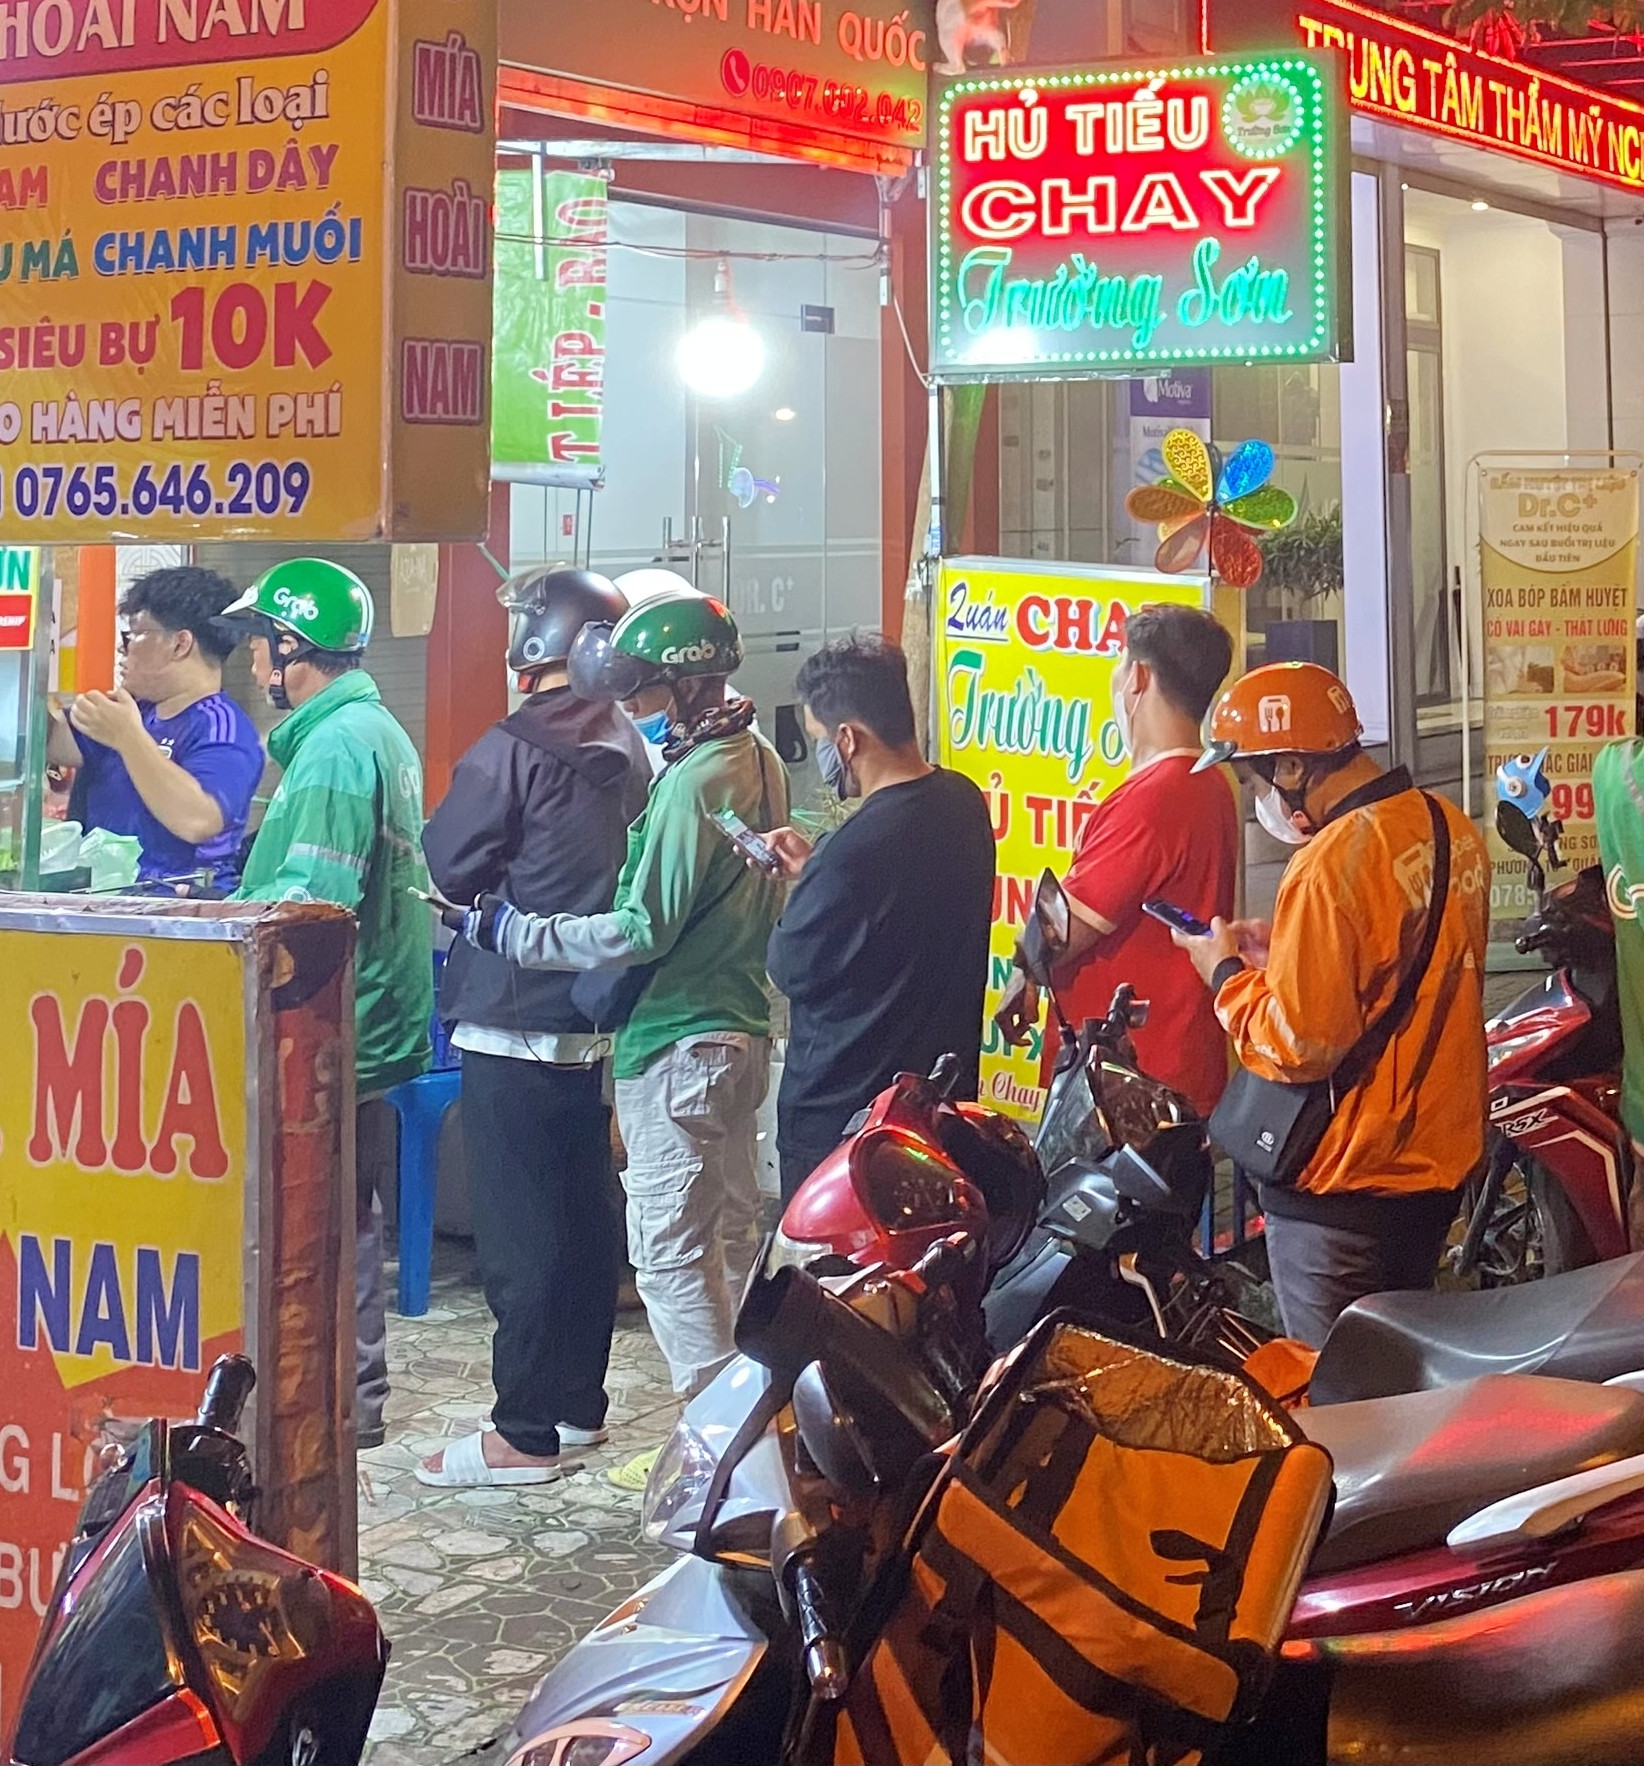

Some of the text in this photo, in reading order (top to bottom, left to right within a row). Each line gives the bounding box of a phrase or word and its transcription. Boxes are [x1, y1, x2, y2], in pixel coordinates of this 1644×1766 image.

[838, 10, 926, 70] QUỐC
[0, 68, 330, 146] ước ép các loại
[414, 34, 482, 132] MÍA
[1422, 51, 1485, 132] TÂM
[1488, 77, 1562, 157] THẨM
[1567, 106, 1601, 168] MỸ
[964, 78, 1209, 162] HỦ TIẾU
[93, 151, 238, 204] CHANH
[247, 138, 339, 192] DÂY
[961, 167, 1281, 239] CHAY
[20, 228, 79, 284] MÁ
[93, 226, 238, 277] CHANH
[247, 201, 363, 268] MUỐI
[406, 180, 484, 279] HOÀI
[0, 278, 333, 375] SIÊU BỰ 10K
[958, 236, 1293, 350] Trường Sơn
[0, 378, 343, 445] O HÀNG MIỄN PHÍ
[404, 340, 484, 422] NAM
[1158, 380, 1192, 399] Motiva
[14, 460, 312, 518] 0765.646.209
[1529, 539, 1548, 548] SAU
[273, 587, 319, 621] Grab
[948, 582, 1129, 653] Quán CHA
[1487, 580, 1628, 612] XOA BÓP BẤM HUYỆT
[1505, 619, 1525, 637] VAI
[661, 638, 717, 664] Grab
[948, 650, 1091, 782] Trường
[1544, 704, 1627, 738] 179k
[28, 946, 230, 1180] MÍA
[991, 1071, 1041, 1112] Chay
[16, 1235, 201, 1373] NAM
[1393, 1560, 1558, 1618] VISION
